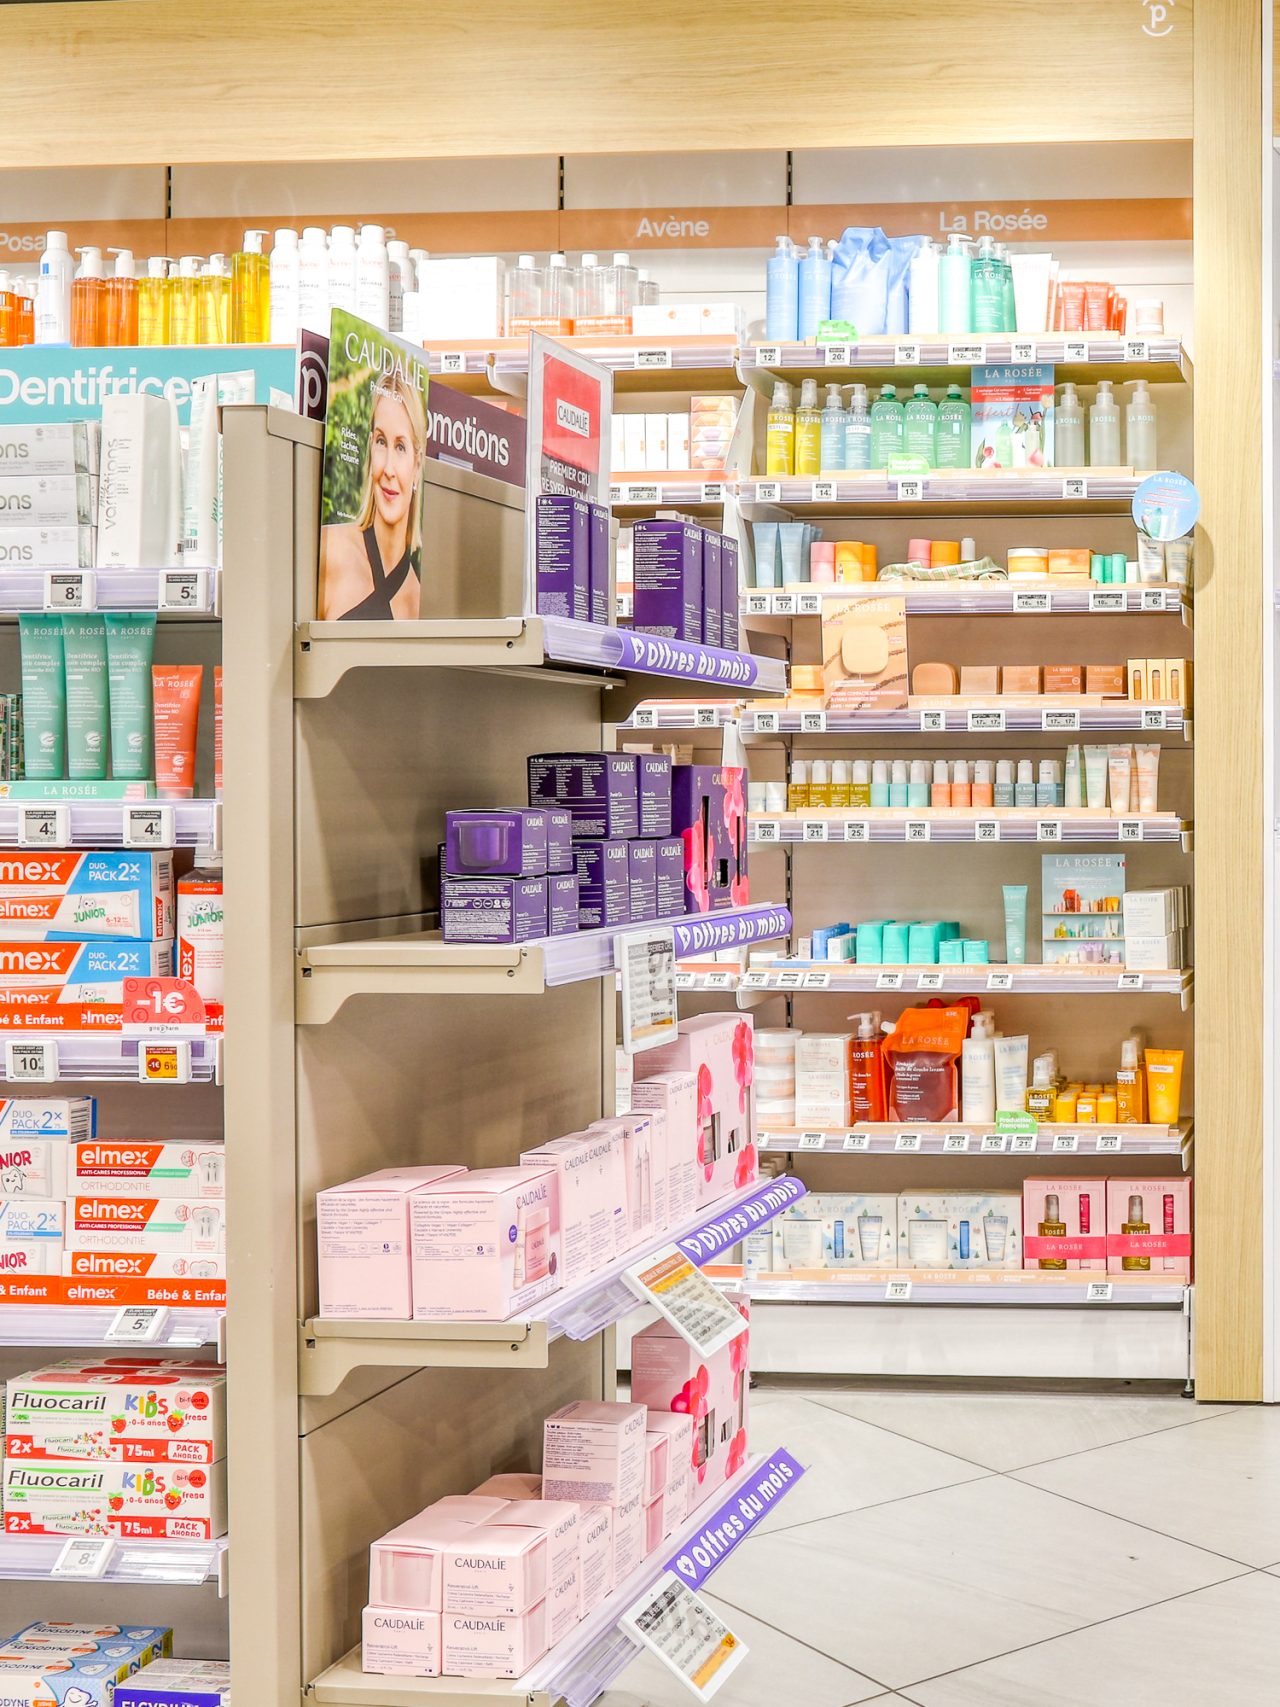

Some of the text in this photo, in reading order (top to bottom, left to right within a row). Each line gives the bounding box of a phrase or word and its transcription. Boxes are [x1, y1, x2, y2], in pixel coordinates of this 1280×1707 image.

[939, 207, 1048, 233] La Rosée
[636, 217, 710, 238] Avène
[0, 233, 46, 252] Posa
[984, 366, 1043, 380] LA ROSÉE
[370, 381, 393, 399] Premier
[550, 459, 590, 488] PREMIER CRU
[699, 651, 716, 678] du
[716, 656, 752, 683] mois
[43, 783, 97, 796] LA ROSÉE
[1055, 856, 1112, 867] LA ROSÉE
[88, 870, 118, 882] PACK
[73, 907, 106, 923] JUNIOR
[738, 913, 755, 942] du
[756, 907, 786, 936] mois
[88, 960, 118, 971] PACK
[29, 1013, 64, 1025] Enfant
[81, 1010, 123, 1024] elmex
[901, 1034, 950, 1047] LA ROSÉE
[11, 1119, 40, 1129] PACK
[80, 1146, 150, 1165] elmex
[80, 1181, 151, 1192] ORTHODONTIE
[741, 1200, 769, 1222] du
[761, 1181, 799, 1210] mois
[79, 1199, 145, 1219] elmex
[7, 1220, 35, 1231] PACK
[78, 1235, 145, 1246] ORTHODONTIE
[1142, 1240, 1167, 1248] ROSÉE
[75, 1254, 142, 1274] elmex
[9, 1286, 47, 1296] Enfant
[67, 1283, 192, 1301] elmex Bébé &
[11, 1391, 169, 1419] Fluocaril KIDS
[176, 1443, 200, 1454] PACK
[172, 1452, 203, 1461] AHORRO
[7, 1469, 166, 1496] Fluocaril KIDS
[737, 1493, 764, 1520] du
[756, 1462, 794, 1502] mois
[170, 1529, 201, 1538] AHORRO
[174, 1522, 198, 1531] PACK
